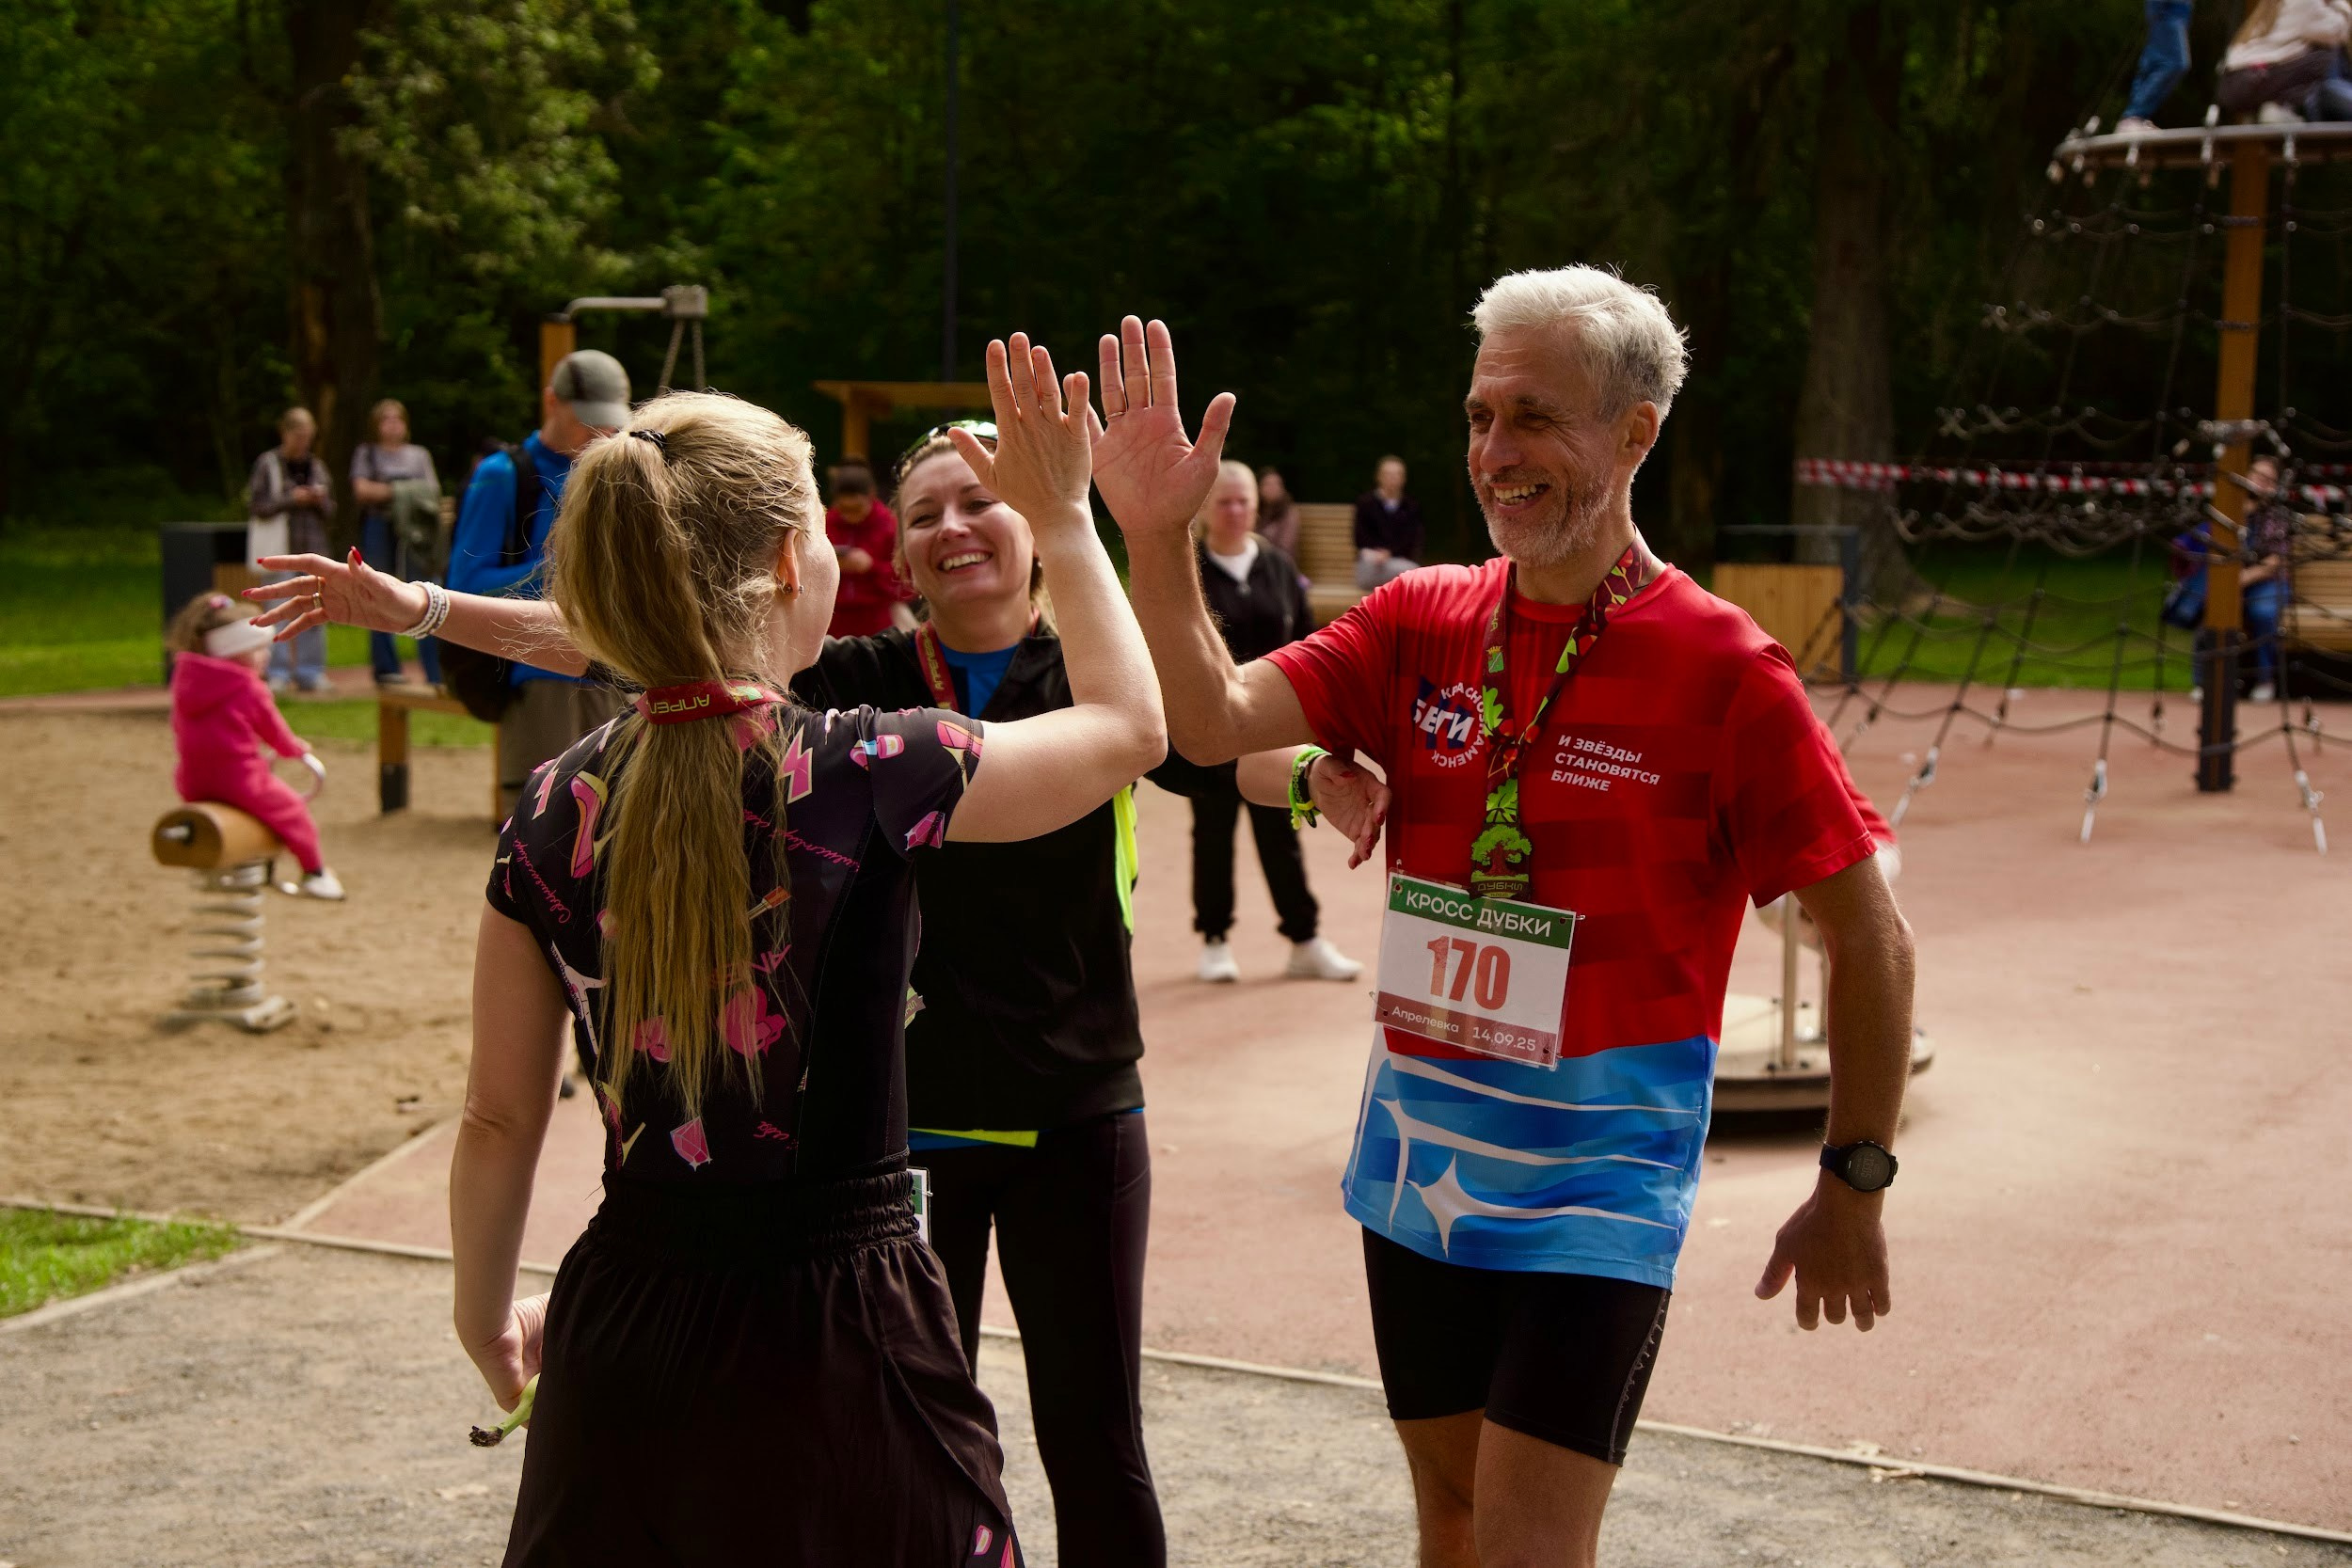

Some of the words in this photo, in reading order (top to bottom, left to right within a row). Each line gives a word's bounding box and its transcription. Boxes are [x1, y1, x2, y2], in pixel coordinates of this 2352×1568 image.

[1558, 734, 1572, 747] И
[1572, 737, 1643, 764] ЗВЁЗДЫ
[1550, 769, 1612, 792] БЛИЖЕ
[1554, 752, 1661, 785] СТАНОВЯТСЯ
[1477, 881, 1524, 893] ДУБКИ
[1406, 890, 1473, 921] КРОСС
[1477, 908, 1551, 938] ДУБКИ
[1426, 935, 1511, 1011] 170
[1391, 1006, 1459, 1033] Апрелевка
[1472, 1026, 1536, 1052] 14.09.25
